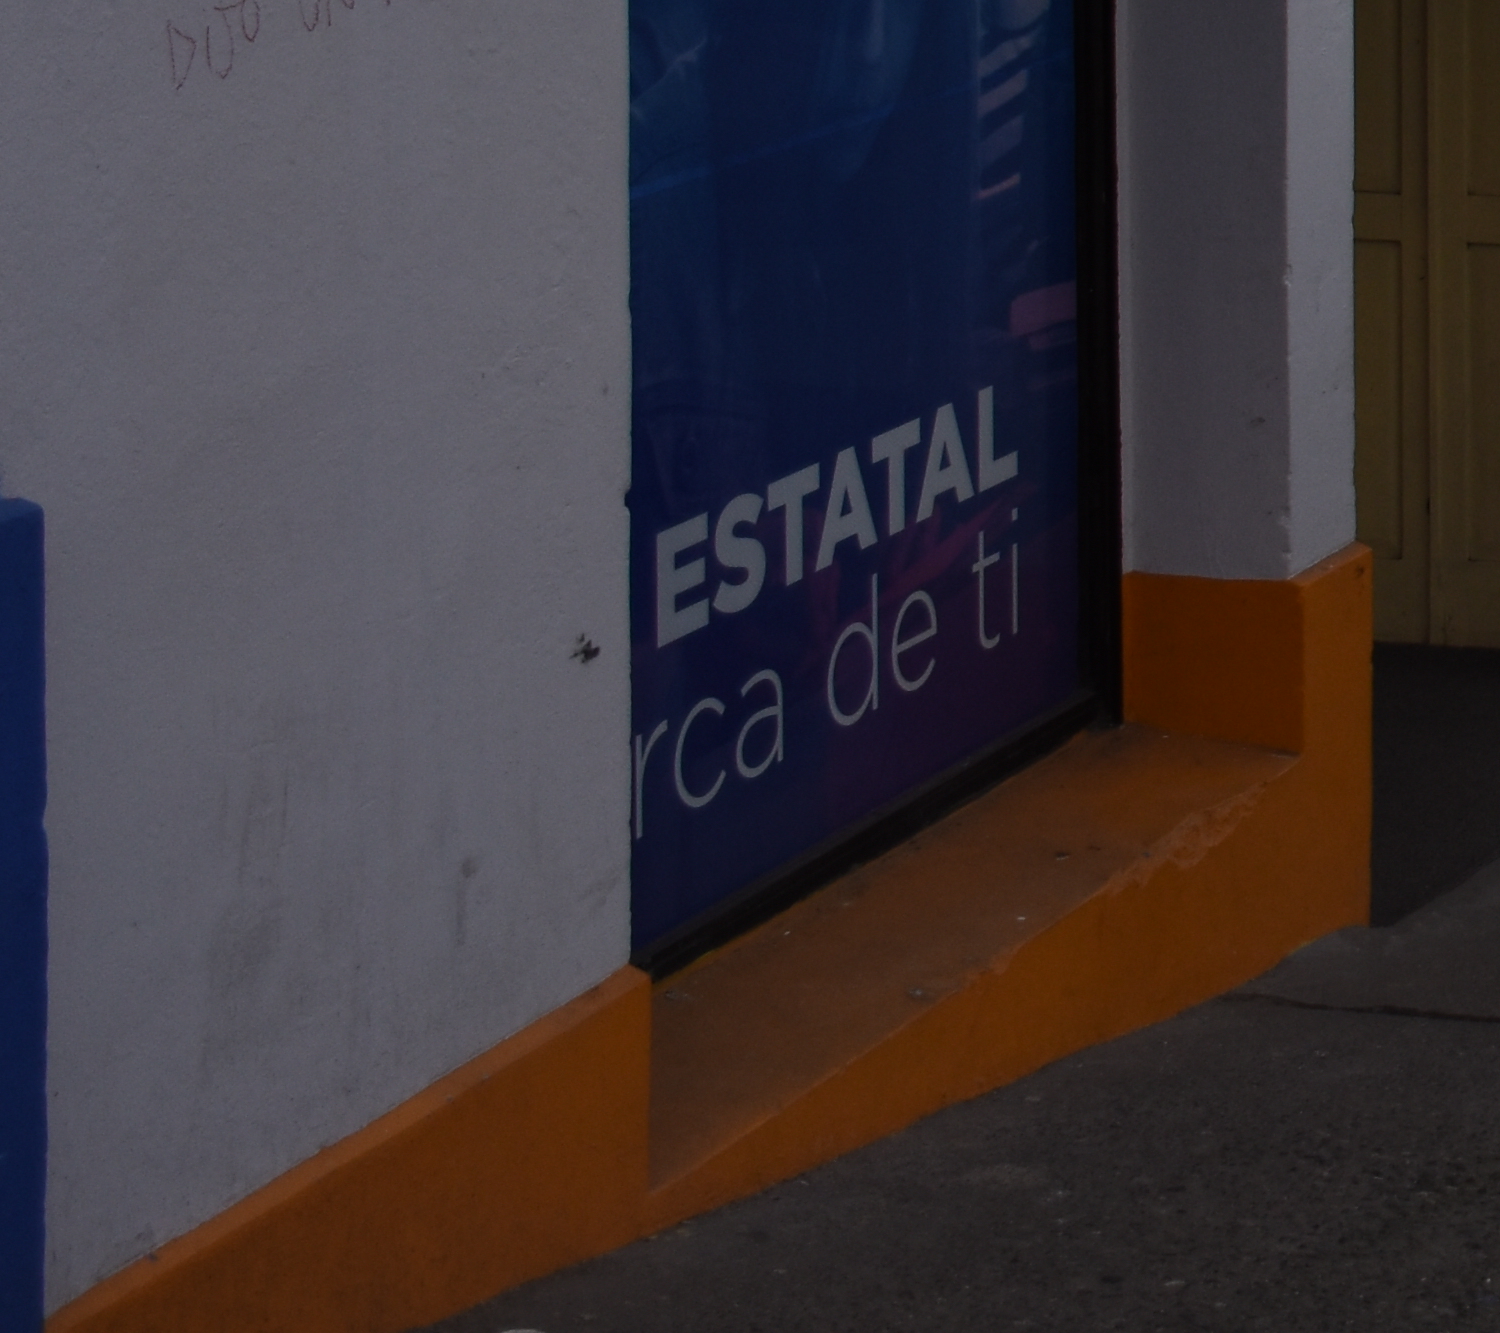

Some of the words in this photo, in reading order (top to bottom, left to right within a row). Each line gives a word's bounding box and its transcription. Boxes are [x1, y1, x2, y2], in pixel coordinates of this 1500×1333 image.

[656, 385, 1019, 649] ESTATAL
[827, 573, 939, 727] de
[972, 507, 1020, 650] ti
